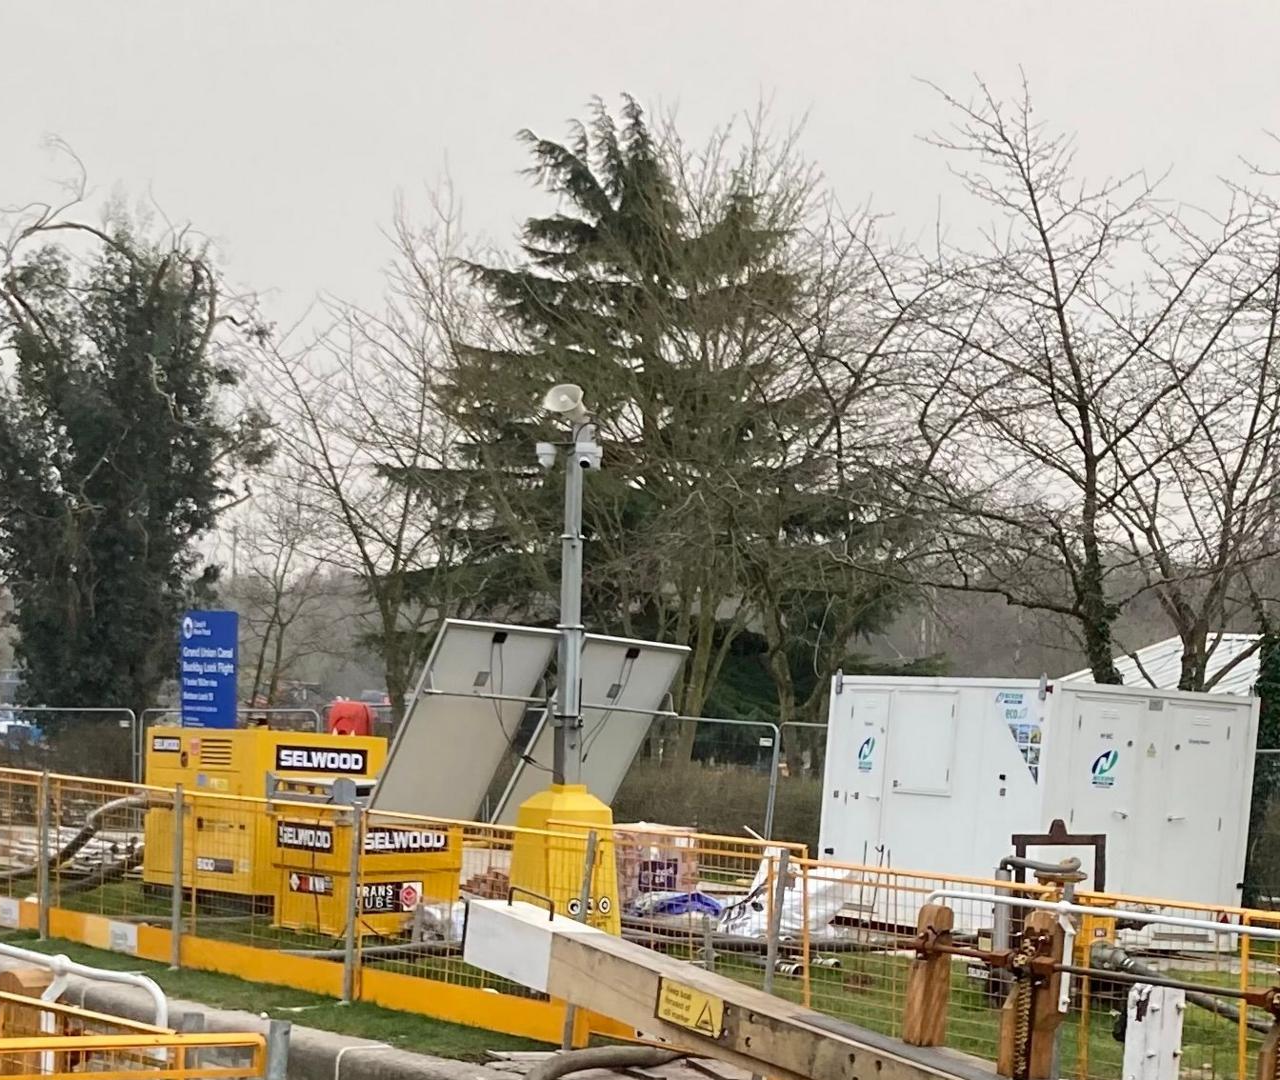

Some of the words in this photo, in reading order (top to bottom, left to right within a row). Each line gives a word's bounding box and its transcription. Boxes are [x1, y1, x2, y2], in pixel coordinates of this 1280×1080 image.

[280, 749, 363, 770] SELWOOD
[279, 826, 331, 849] SELWOOD
[364, 832, 445, 850] SELWOOD
